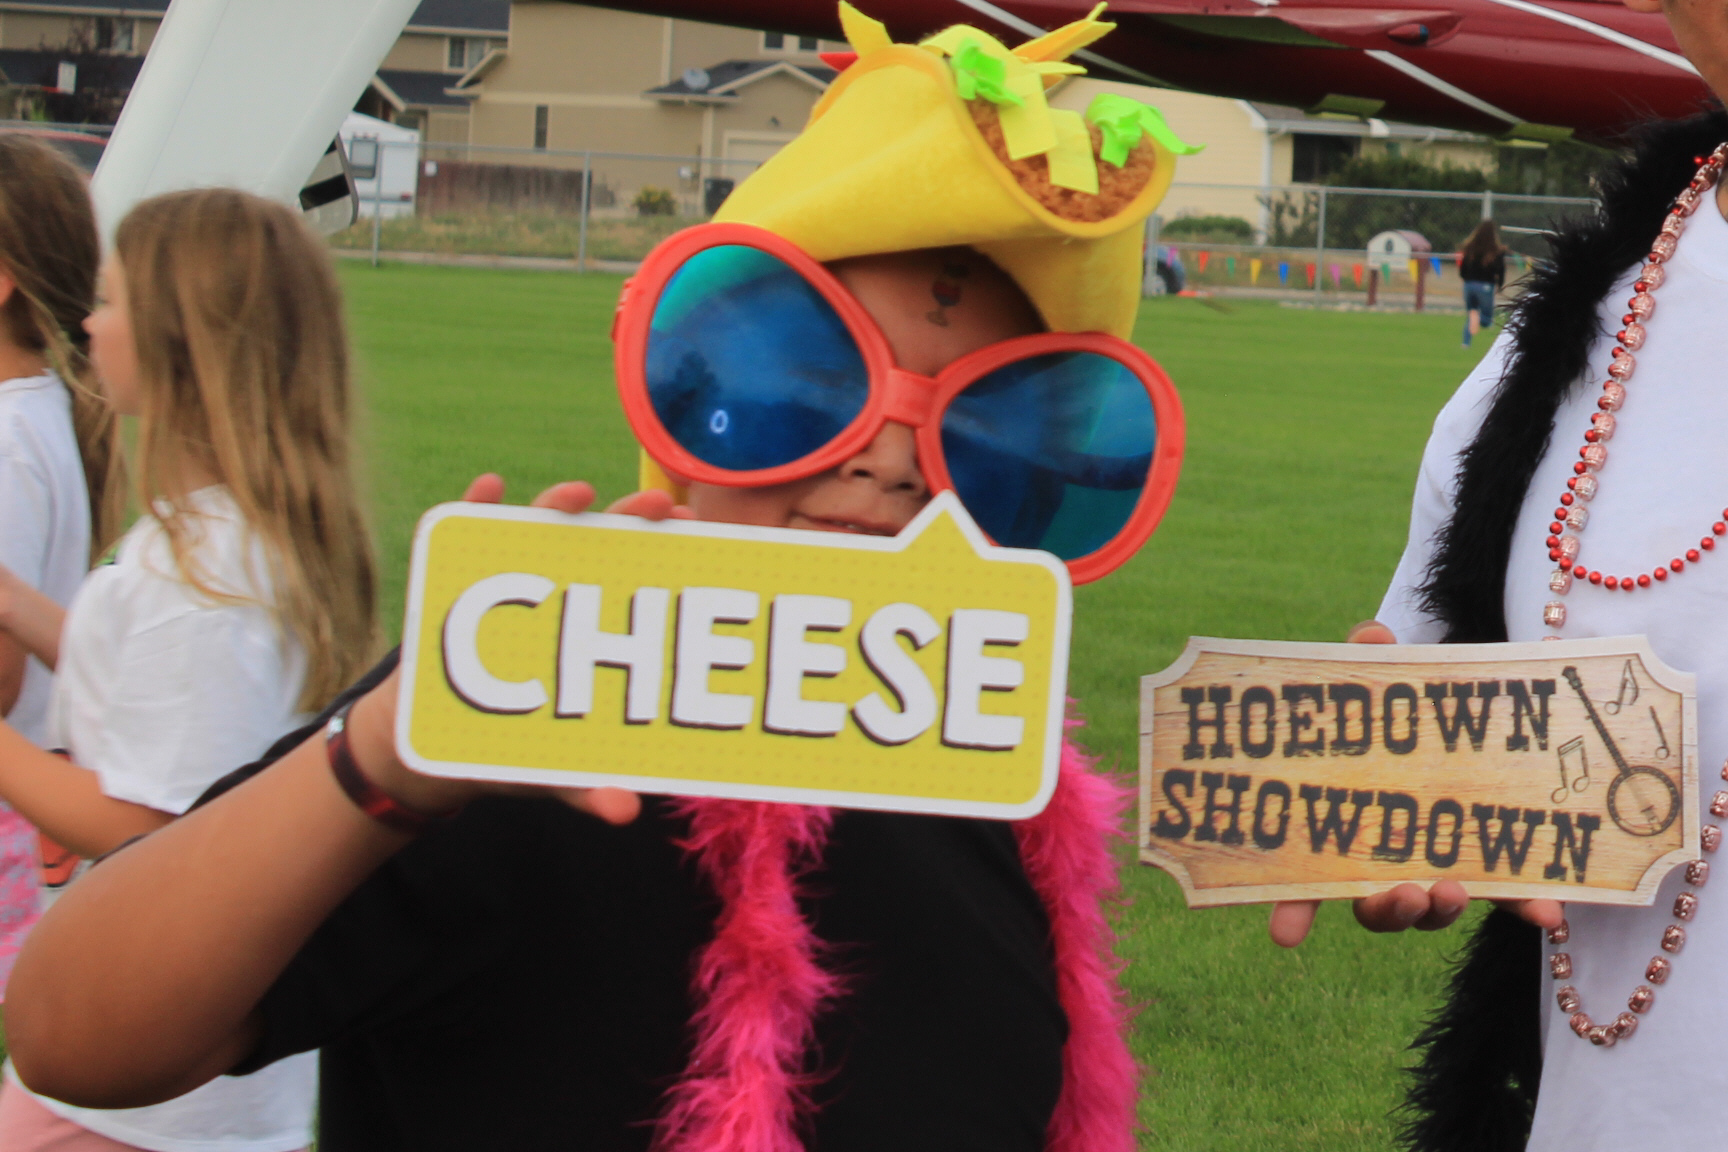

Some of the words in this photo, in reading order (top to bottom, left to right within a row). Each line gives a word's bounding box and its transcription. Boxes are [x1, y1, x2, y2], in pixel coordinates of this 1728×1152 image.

[441, 571, 1029, 750] CHEESE
[1181, 678, 1556, 760] HOEDOWN
[1149, 768, 1601, 883] SHOWDOWN
